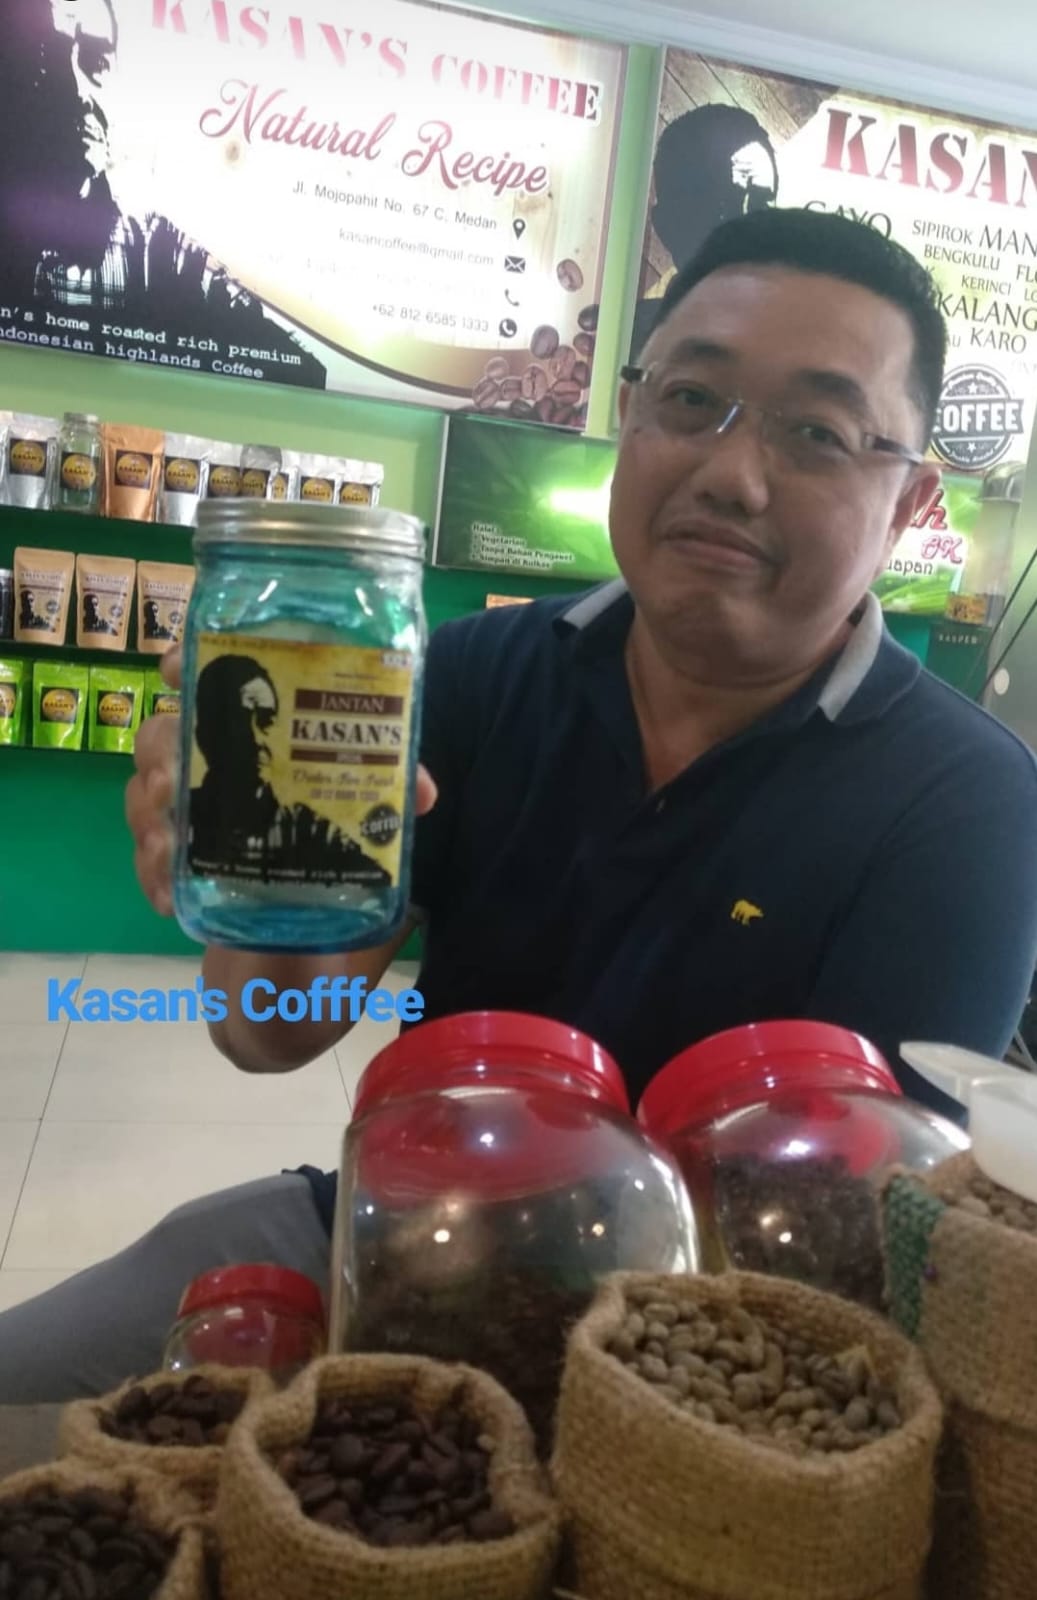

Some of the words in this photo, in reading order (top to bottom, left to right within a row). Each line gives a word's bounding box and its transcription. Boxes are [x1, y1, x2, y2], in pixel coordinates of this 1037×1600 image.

[431, 53, 599, 121] COFFEE
[199, 78, 396, 161] Natural
[401, 120, 548, 196] Recipe
[292, 180, 306, 195] Jl.
[314, 184, 379, 209] Mojopahit
[412, 204, 429, 217] 67
[454, 211, 498, 230] Medan
[339, 228, 495, 266] kasancoffee@gmail.com
[912, 218, 973, 245] SIPIROK
[923, 243, 1001, 271] BENGKULU
[961, 274, 1012, 296] KERINCI
[372, 303, 394, 317] +62
[400, 306, 421, 322] 812
[425, 310, 456, 328] 6585
[461, 317, 489, 333] 1333
[46, 312, 90, 331] home
[101, 323, 167, 344] roasted
[177, 335, 219, 353] rich
[228, 344, 302, 366] premium
[970, 327, 1027, 354] KARO
[105, 342, 201, 368] highlands
[212, 359, 264, 379] Coffee
[291, 719, 402, 745] KASAN'S
